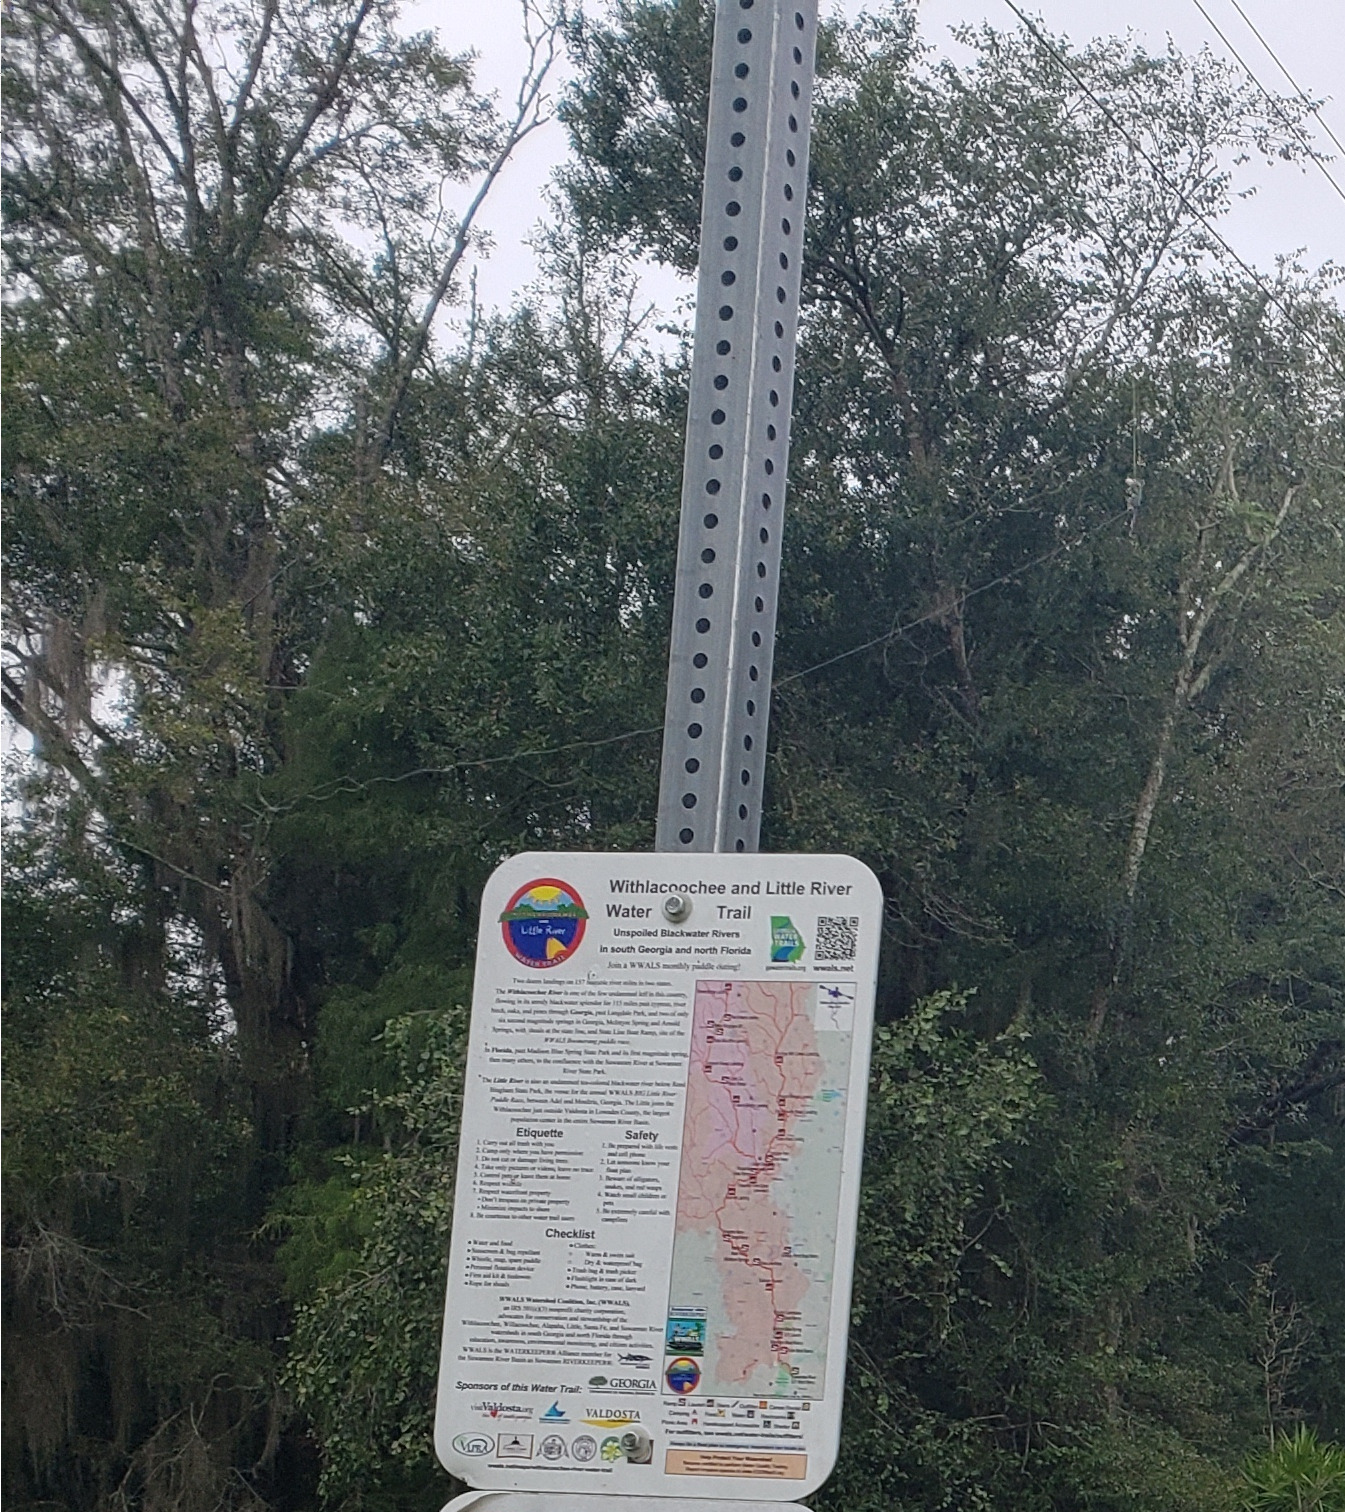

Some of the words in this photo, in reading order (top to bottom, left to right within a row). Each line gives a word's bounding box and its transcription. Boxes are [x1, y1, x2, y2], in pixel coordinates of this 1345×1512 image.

[610, 879, 725, 894] Withlacoochee
[731, 882, 760, 894] and
[766, 881, 805, 895] Little
[811, 882, 852, 895] River
[607, 904, 652, 918] Water
[717, 905, 751, 919] Trail
[521, 925, 543, 935] Little
[546, 925, 565, 934] River
[614, 929, 658, 939] Unspoiled
[661, 929, 709, 938] Blackwater
[712, 930, 740, 938] Rivers
[600, 945, 608, 953] in
[638, 946, 672, 955] Georgia
[676, 946, 691, 954] and
[721, 947, 751, 955] Florida
[516, 1128, 564, 1138] Etiquette
[625, 1130, 658, 1142] Safety
[545, 1228, 595, 1239] Checklist
[456, 1381, 498, 1391] Sponsors
[501, 1383, 510, 1391] of
[512, 1383, 529, 1391] this
[531, 1384, 557, 1393] Water
[560, 1385, 582, 1394] Trail:
[610, 1378, 656, 1388] GEORGIA
[586, 1409, 640, 1419] VALDOSTA
